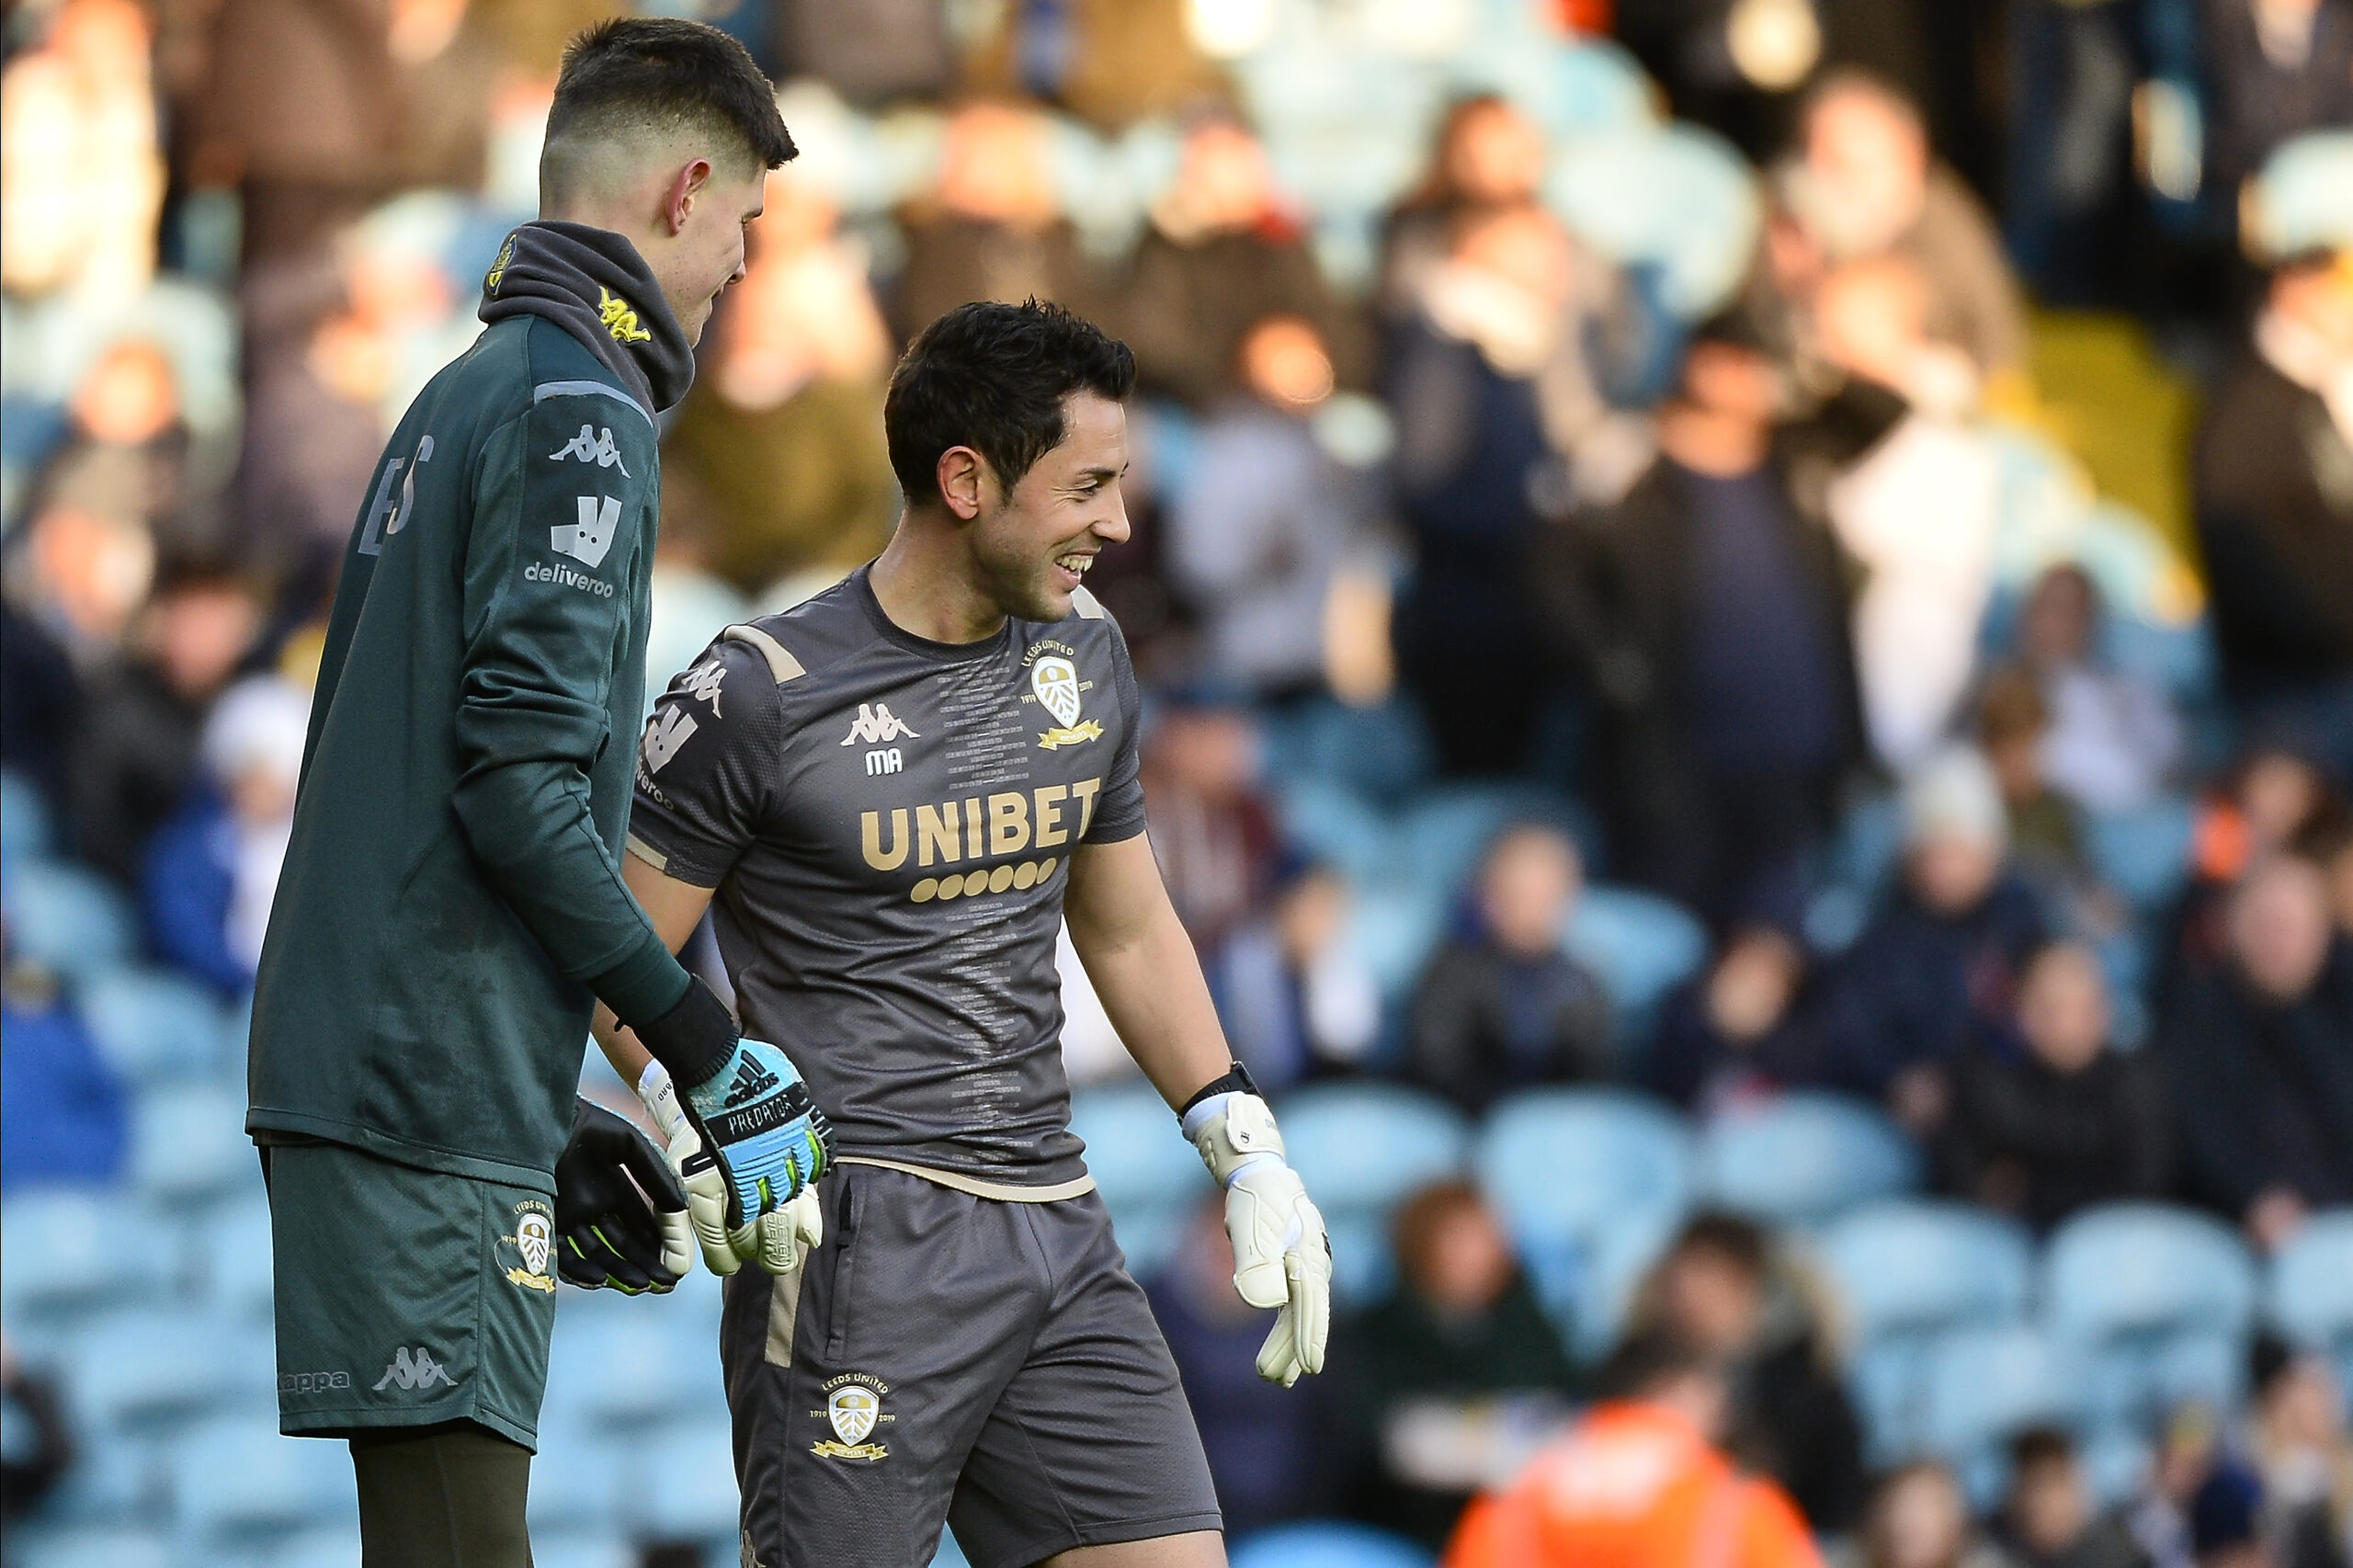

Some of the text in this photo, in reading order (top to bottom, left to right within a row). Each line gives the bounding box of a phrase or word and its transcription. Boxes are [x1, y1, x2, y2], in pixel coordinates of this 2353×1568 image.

[524, 562, 613, 598] deliveroo
[1020, 640, 1074, 667] LEEDS UNITED
[865, 747, 904, 777] MA
[861, 778, 1101, 871] UNIBET
[724, 1072, 779, 1108] adidas
[728, 1094, 798, 1136] PREDATOR
[278, 1371, 350, 1394] appa
[822, 1372, 889, 1394] LEEDS UNITED
